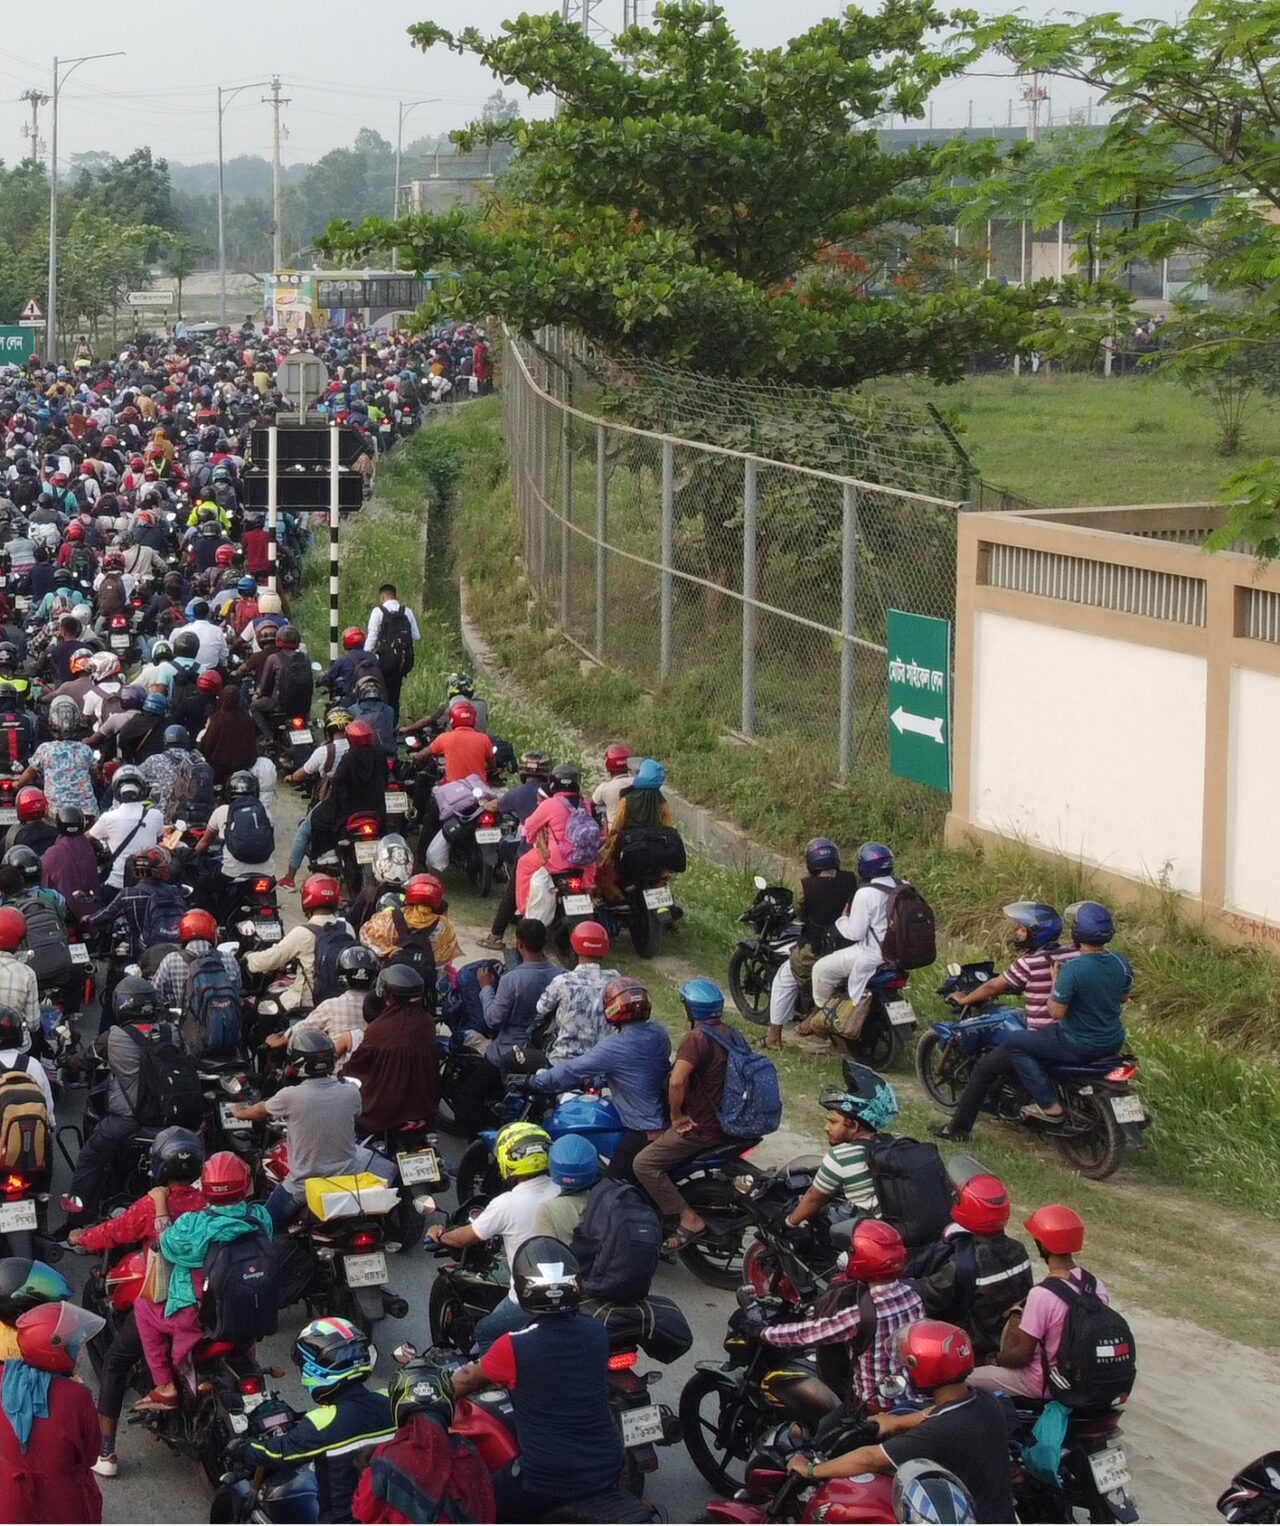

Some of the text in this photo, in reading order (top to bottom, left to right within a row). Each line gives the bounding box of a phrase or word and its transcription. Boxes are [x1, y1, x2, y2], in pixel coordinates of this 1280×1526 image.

[6, 336, 24, 351] লেন
[889, 654, 943, 695] মোটর সাইকেল লেন
